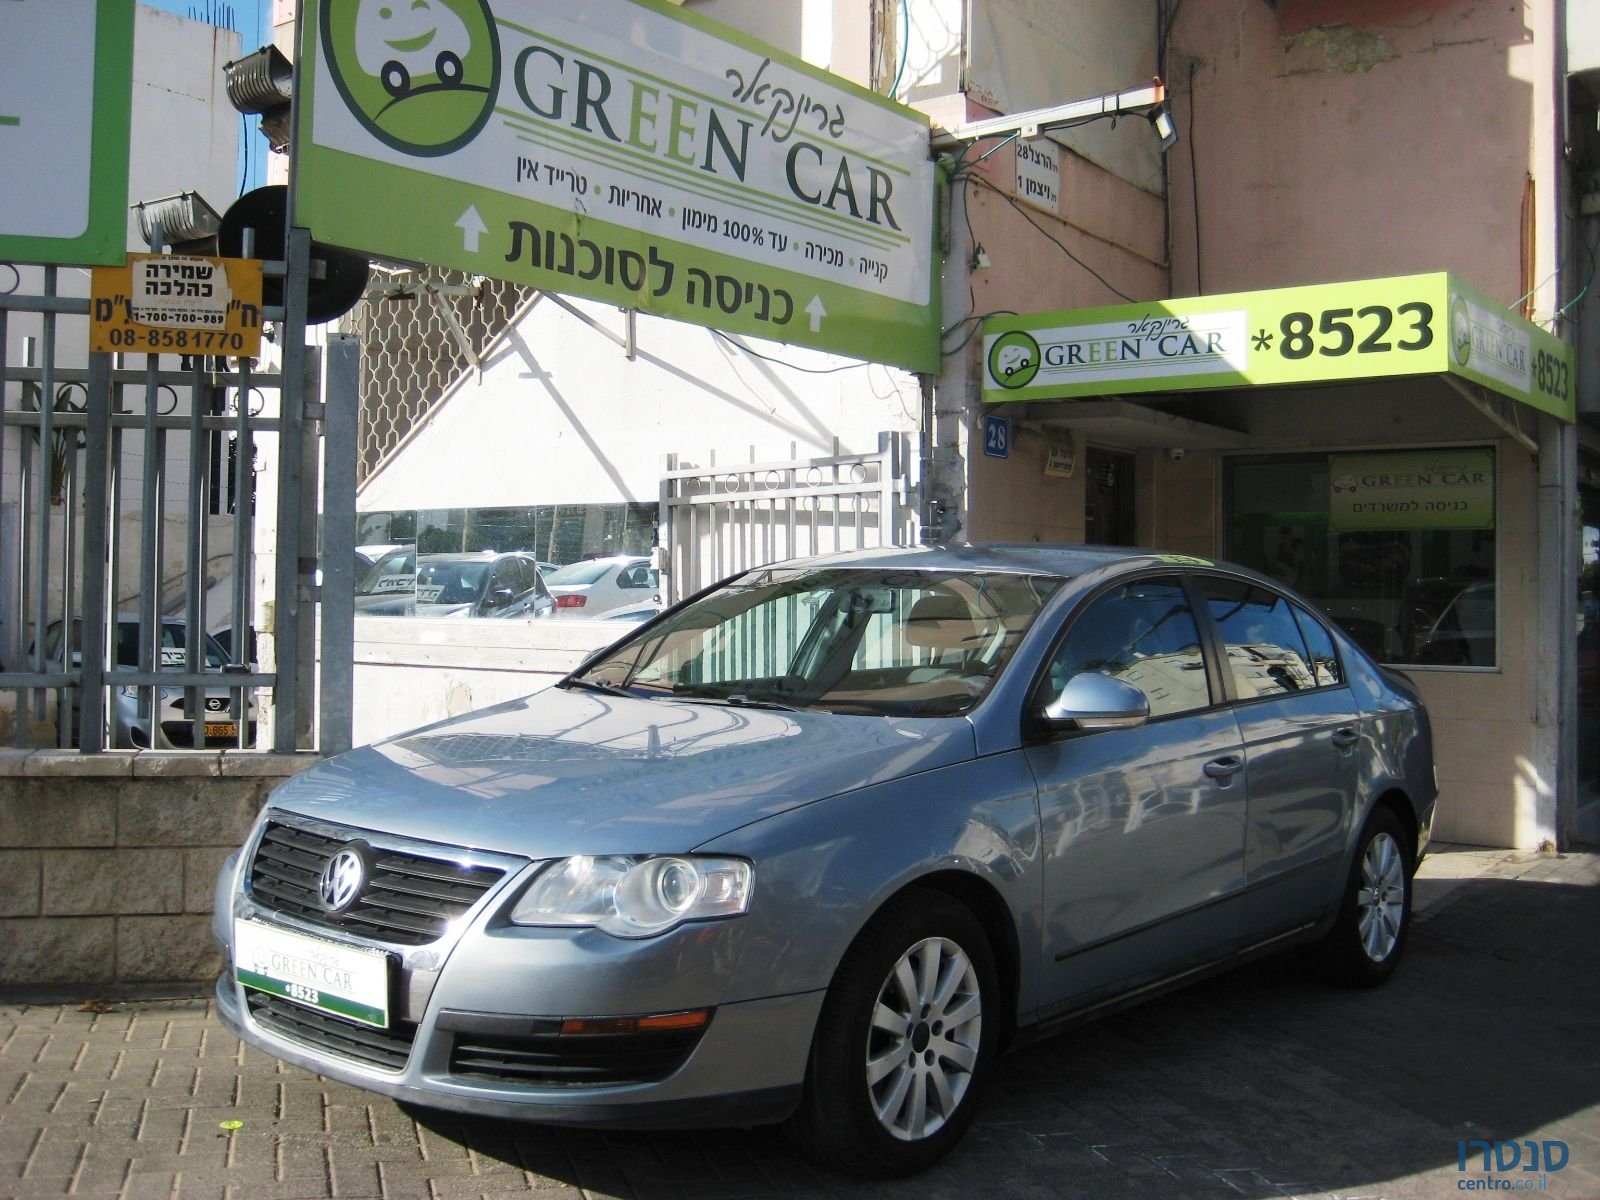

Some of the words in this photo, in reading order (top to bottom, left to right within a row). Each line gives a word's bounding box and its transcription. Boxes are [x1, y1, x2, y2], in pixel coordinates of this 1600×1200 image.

[513, 45, 753, 183] GREEN
[785, 142, 902, 232] CAR
[516, 156, 539, 183] אין
[543, 164, 588, 196] טרייד
[608, 183, 662, 218] אחריות
[681, 205, 718, 233] מימון
[722, 218, 764, 247] 100%
[767, 231, 789, 253] עד
[804, 240, 844, 267] מכירה
[145, 264, 213, 280] שמירה
[504, 220, 675, 298] לסוכנות
[859, 255, 889, 281] קנייה
[145, 280, 213, 298] כהלכה
[686, 266, 794, 326] כניסה
[133, 311, 225, 325] 1-700-700-989
[109, 328, 244, 351] 08-8581770
[1044, 338, 1142, 366] GREEN
[1158, 332, 1227, 357] CAR
[1471, 325, 1503, 360] GREEN
[1506, 343, 1526, 374] CAR
[988, 423, 1006, 450] 28
[1361, 473, 1432, 487] GREEN
[1442, 472, 1485, 486] CAR
[1353, 500, 1419, 513] למשרדים
[1425, 500, 1468, 512] כניסה
[271, 952, 318, 981] GREEN
[323, 967, 353, 991] CAR
